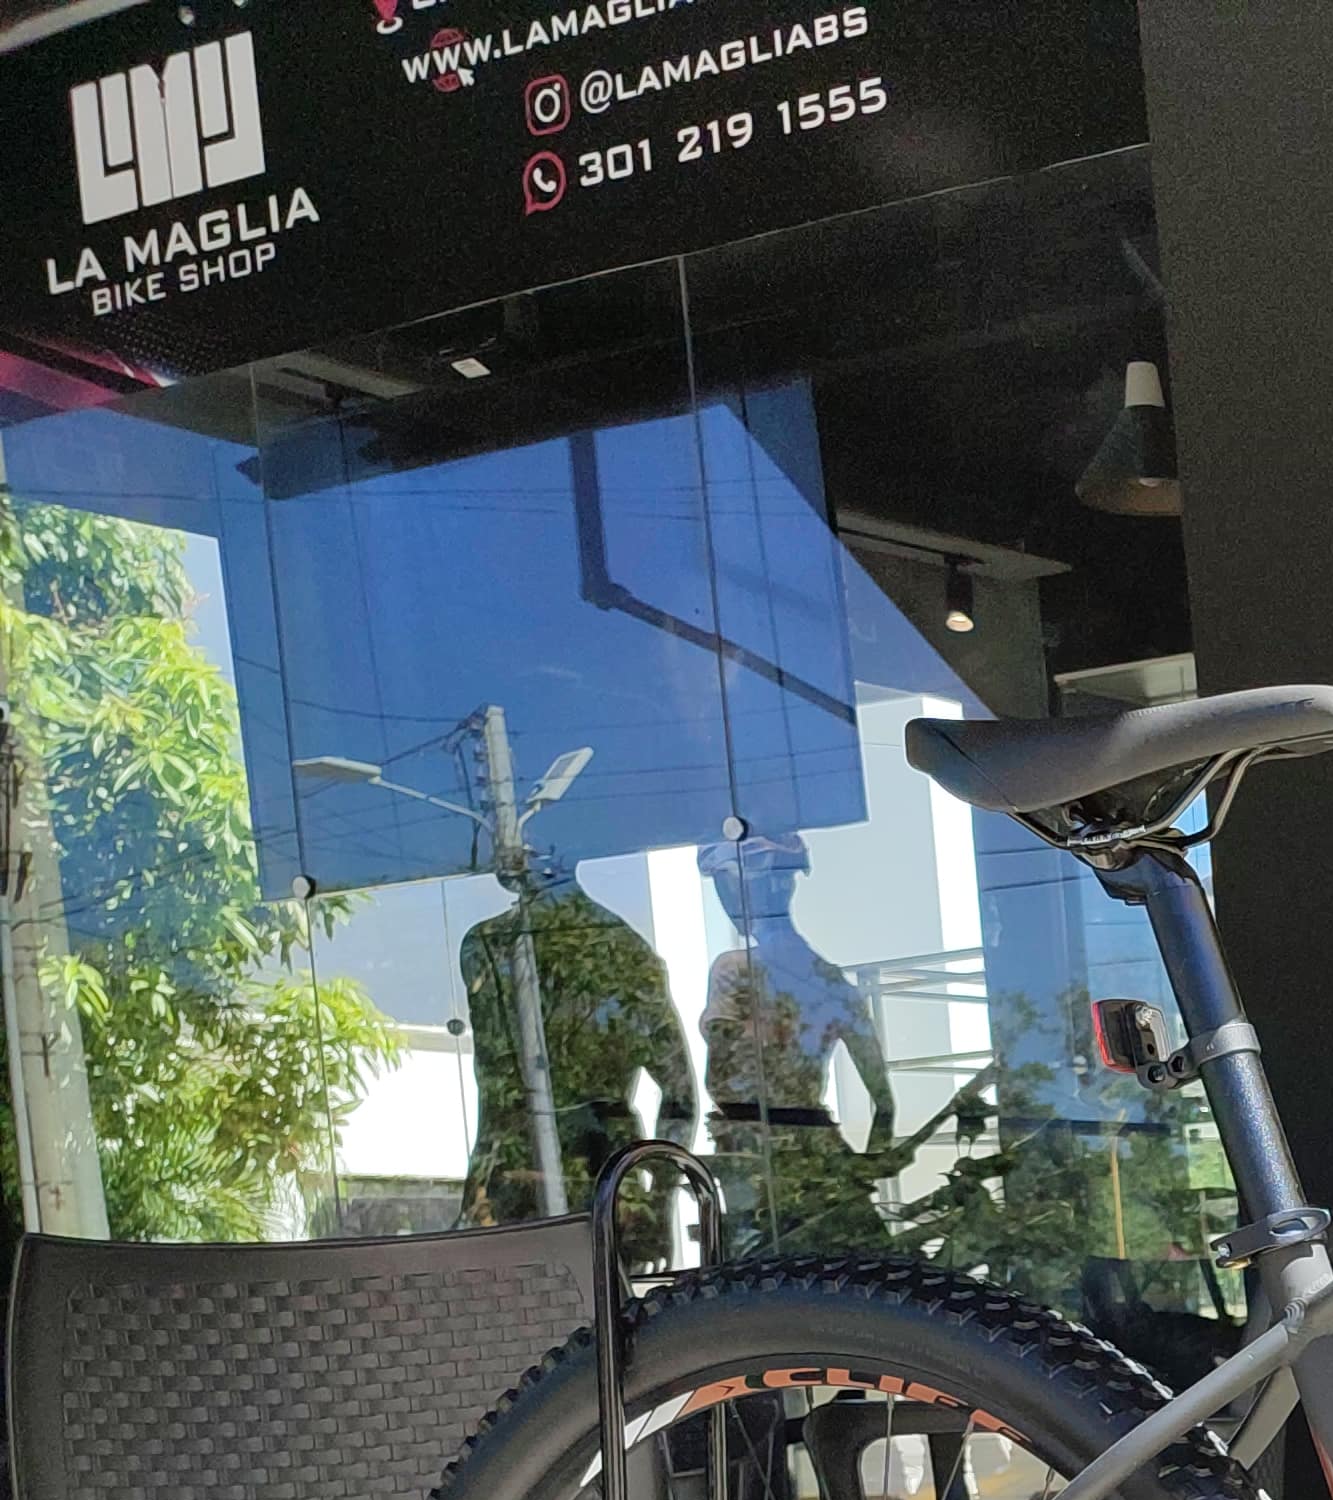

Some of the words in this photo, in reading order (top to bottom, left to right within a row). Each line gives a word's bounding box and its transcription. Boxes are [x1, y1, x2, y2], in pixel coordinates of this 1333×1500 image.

[580, 7, 868, 114] @LAMAGLIABS
[578, 138, 652, 187] 301
[676, 112, 753, 163] 219
[777, 76, 887, 135] 1555
[46, 247, 106, 295] LA
[123, 187, 320, 273] MAGLIA
[91, 271, 167, 316] BIKE
[178, 242, 276, 293] SHOP
[763, 1367, 1033, 1444] CLIFF
